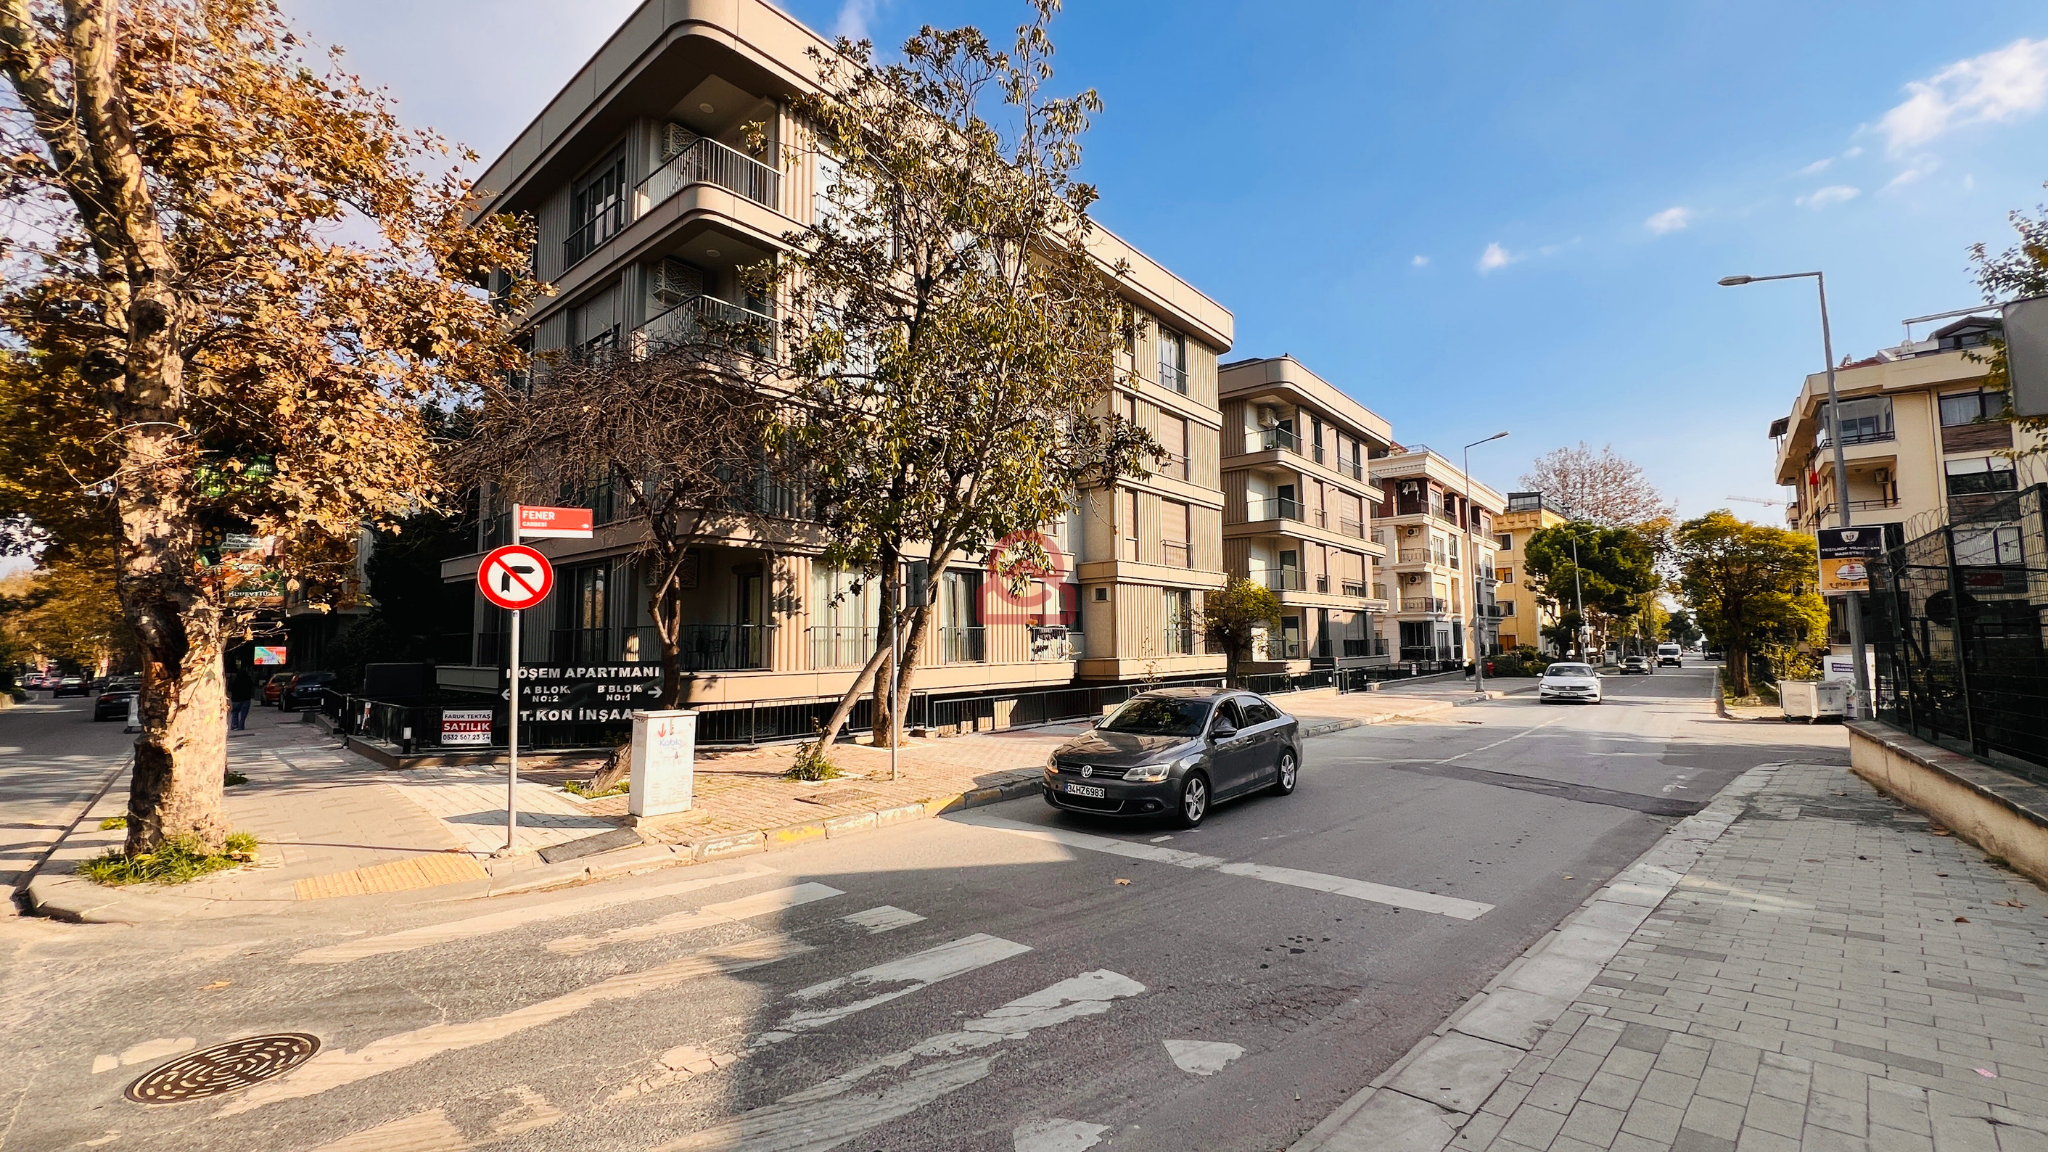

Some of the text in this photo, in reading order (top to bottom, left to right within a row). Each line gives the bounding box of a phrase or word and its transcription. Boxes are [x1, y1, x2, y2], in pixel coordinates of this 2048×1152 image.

[522, 510, 555, 520] FENER
[564, 667, 660, 679] APARTMANI
[523, 685, 571, 694] A BLOK
[597, 684, 643, 693] B BLOK
[606, 693, 631, 701] NO:1
[579, 707, 644, 723] İNŞAA
[443, 722, 490, 731] SATILIK
